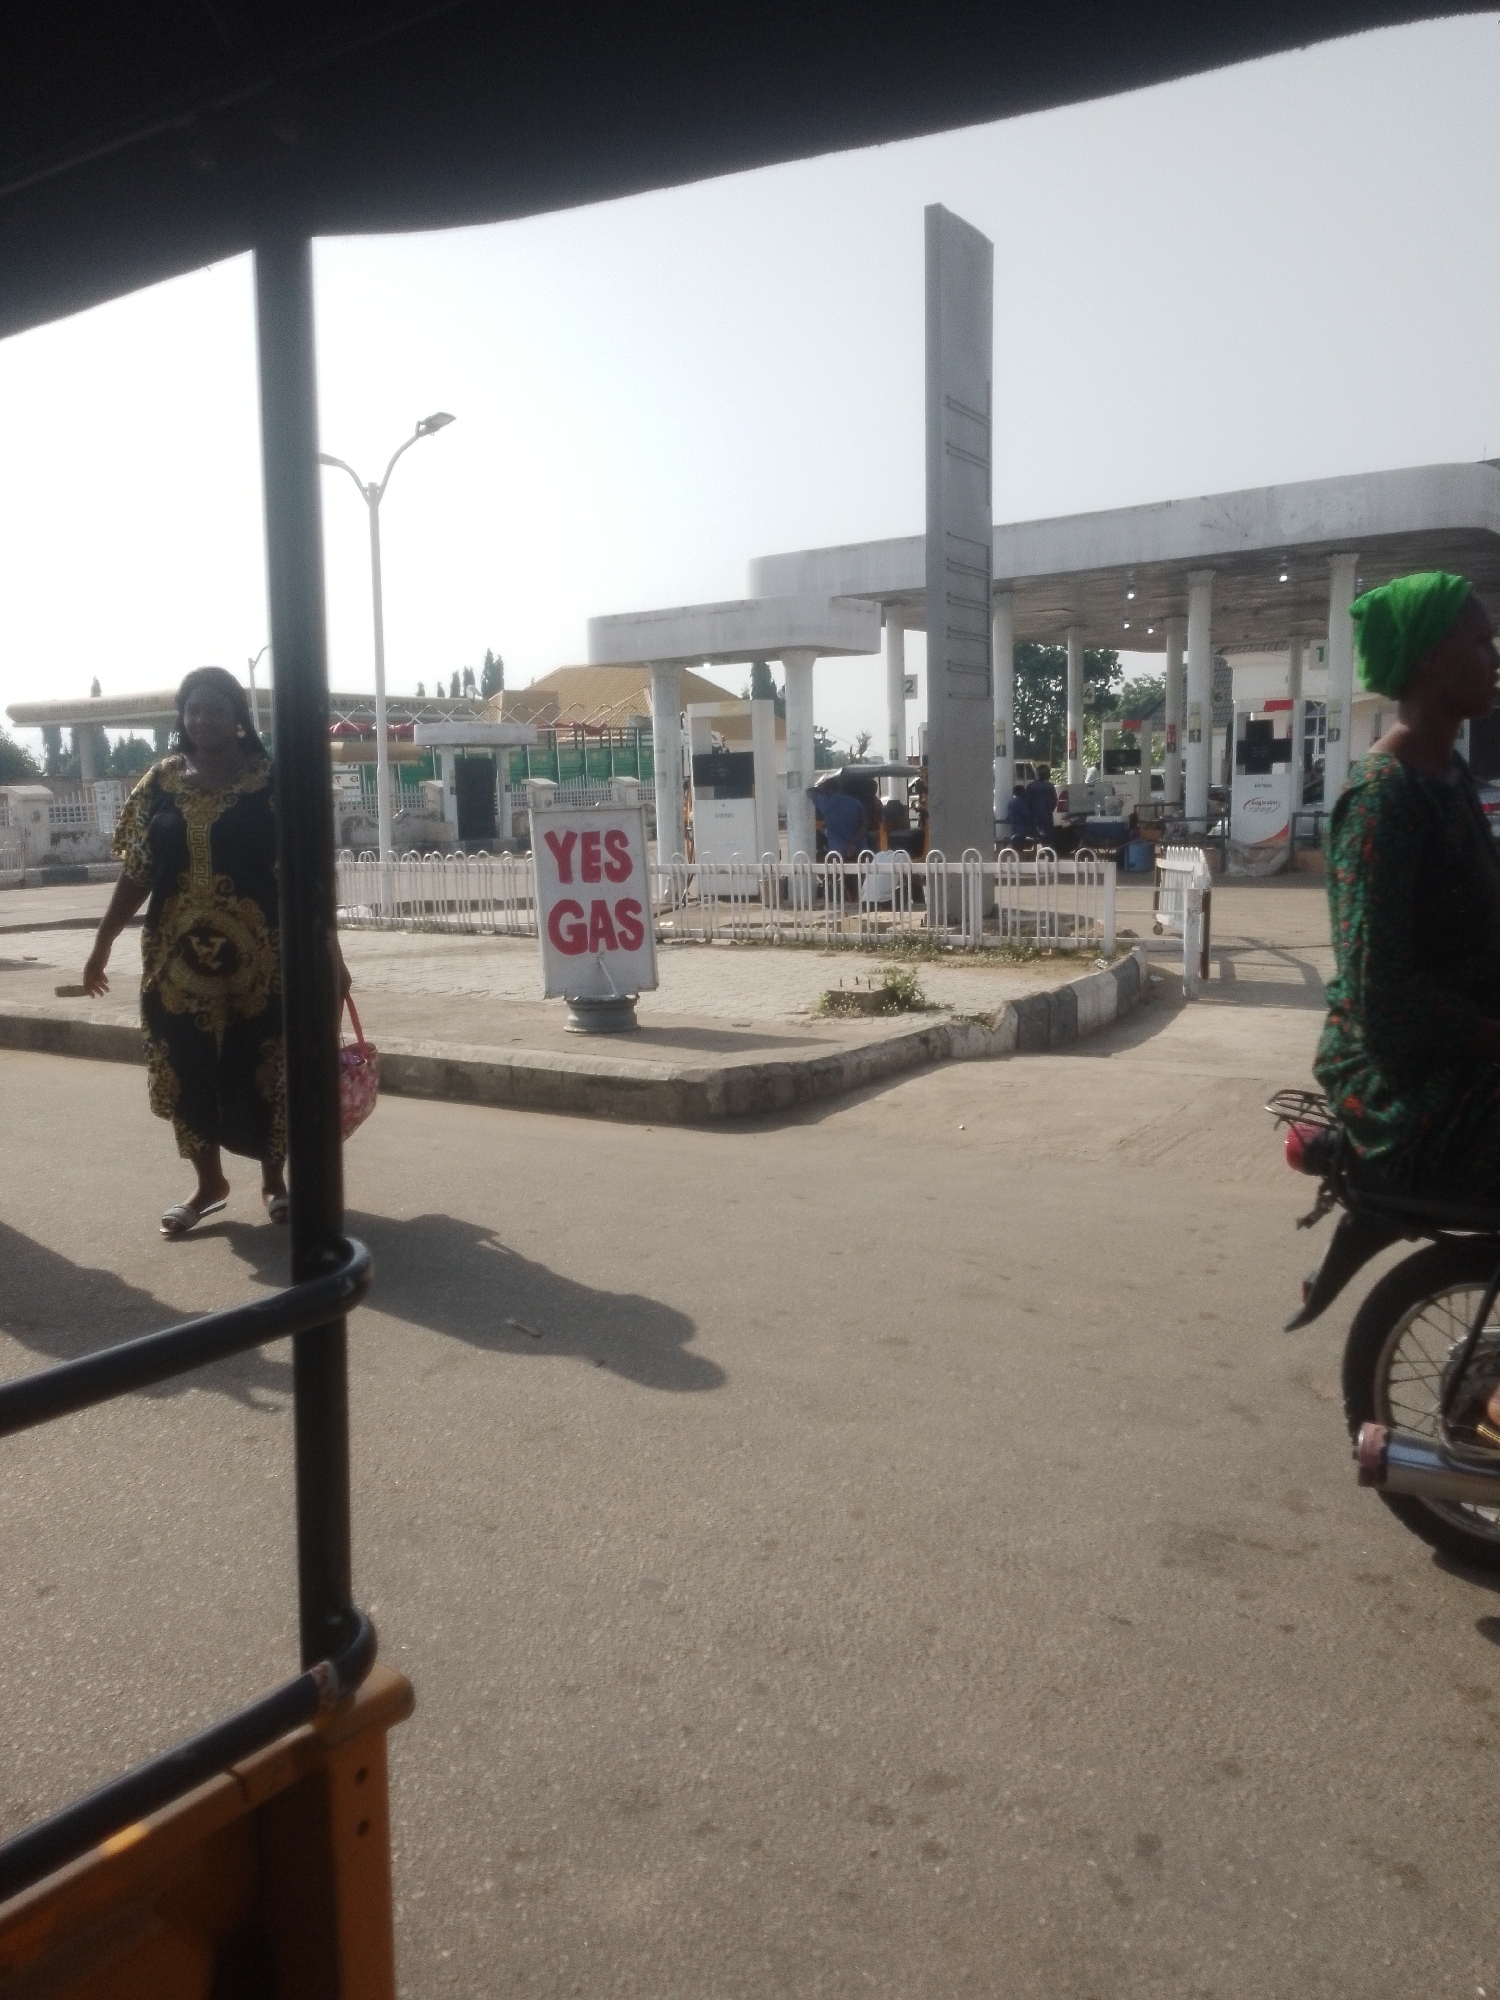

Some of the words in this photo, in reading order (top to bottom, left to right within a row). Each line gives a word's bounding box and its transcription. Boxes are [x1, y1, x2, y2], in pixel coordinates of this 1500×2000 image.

[1315, 645, 1325, 663] 1
[904, 679, 914, 693] 2
[1083, 687, 1093, 700] 4
[543, 829, 634, 884] YES
[547, 897, 645, 956] GAS
